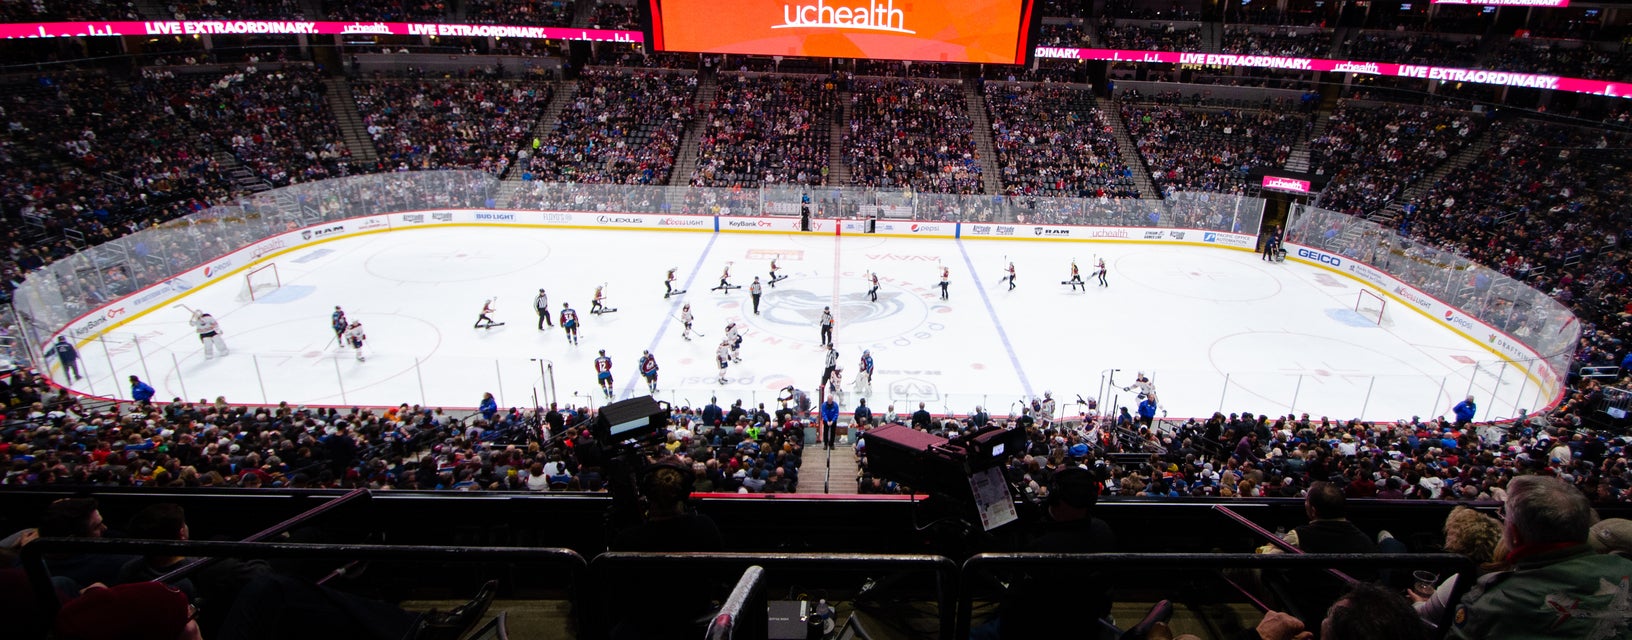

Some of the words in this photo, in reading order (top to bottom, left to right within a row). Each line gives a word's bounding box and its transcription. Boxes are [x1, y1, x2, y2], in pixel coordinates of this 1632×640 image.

[784, 0, 904, 31] uchealth
[145, 22, 182, 34] LIVE
[184, 22, 319, 34] EXTRAORDINARY.
[344, 22, 389, 33] uchealth
[407, 24, 437, 36] LIVE
[438, 25, 547, 38] EXTRAORDINARY.
[1179, 53, 1207, 65] LIVE
[1206, 54, 1312, 70] EXTRAORDINARY.
[1335, 61, 1379, 74] uchealth
[1398, 64, 1428, 79] LIVE
[1429, 67, 1558, 90] EXTRAORDINARY.
[492, 213, 515, 221] LIGHT
[665, 217, 687, 226] Coors
[729, 220, 757, 228] KeyBank
[314, 225, 344, 236] RAM
[1092, 228, 1128, 237] uchealth
[1298, 248, 1341, 267] GEICO
[213, 260, 232, 274] pepsi
[1400, 287, 1416, 302] Coors
[1415, 298, 1432, 310] LIGHT
[76, 316, 107, 335] KeyBank
[1453, 316, 1473, 330] pepsi
